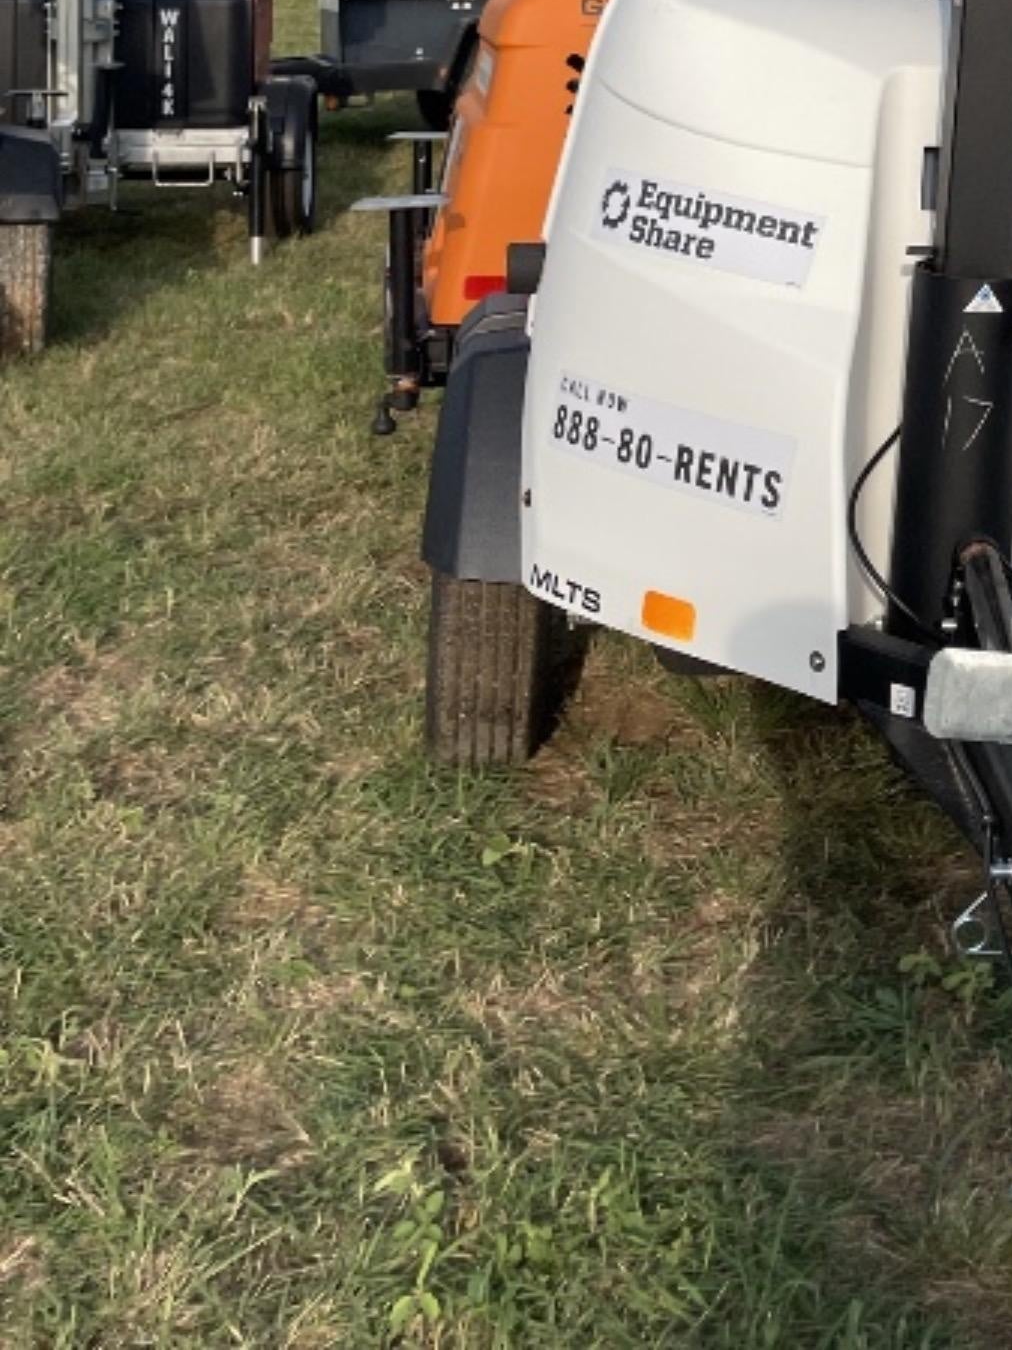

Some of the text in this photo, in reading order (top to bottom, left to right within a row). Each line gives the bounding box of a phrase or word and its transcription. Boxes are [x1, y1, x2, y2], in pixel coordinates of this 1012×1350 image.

[629, 215, 716, 259] Share
[637, 180, 820, 249] Equipment
[553, 404, 783, 508] 888-80-RENTS
[530, 564, 601, 613] MLTS
